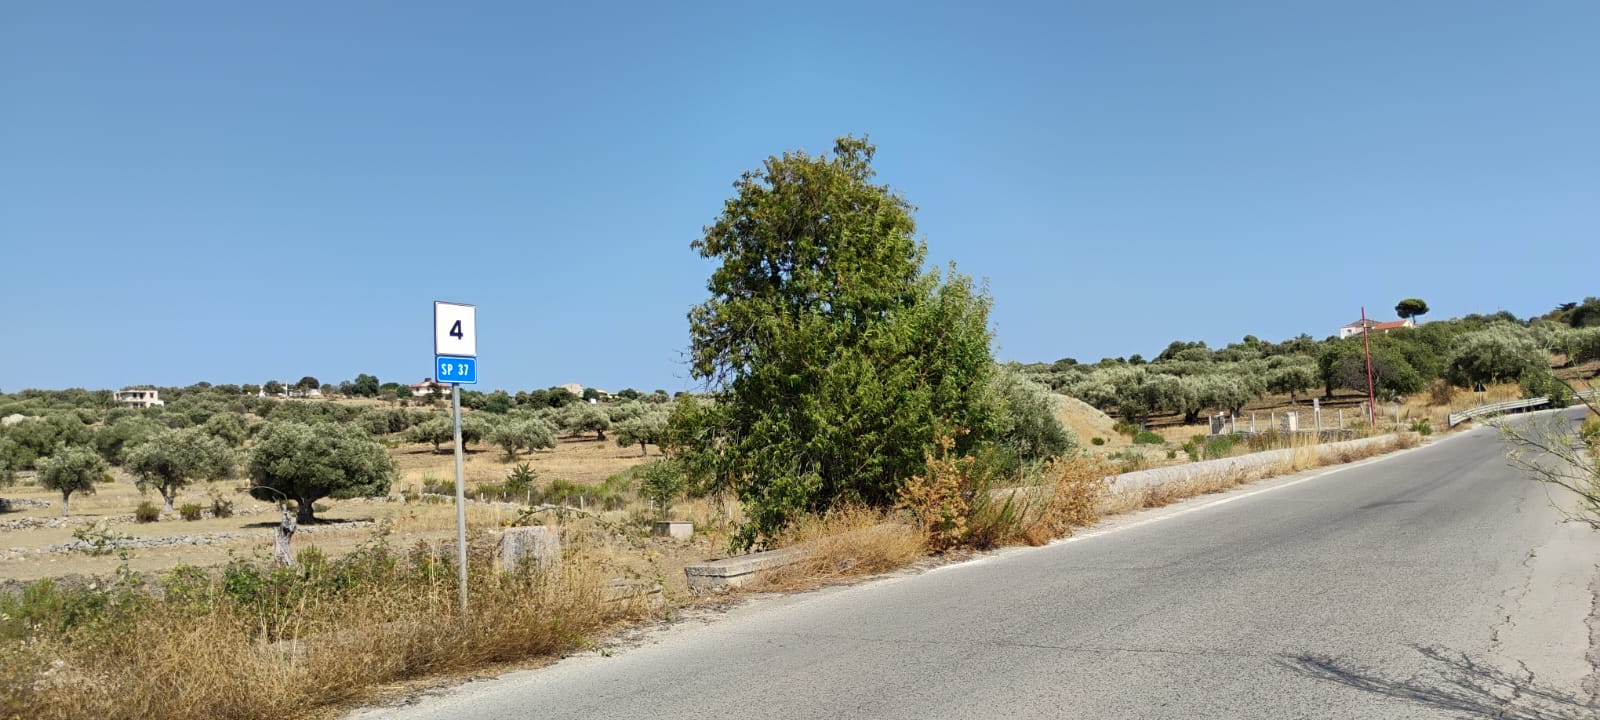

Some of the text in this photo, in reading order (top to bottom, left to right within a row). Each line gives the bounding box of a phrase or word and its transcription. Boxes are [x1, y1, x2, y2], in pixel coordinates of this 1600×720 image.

[449, 319, 464, 340] 4
[441, 363, 469, 376] SP 37
